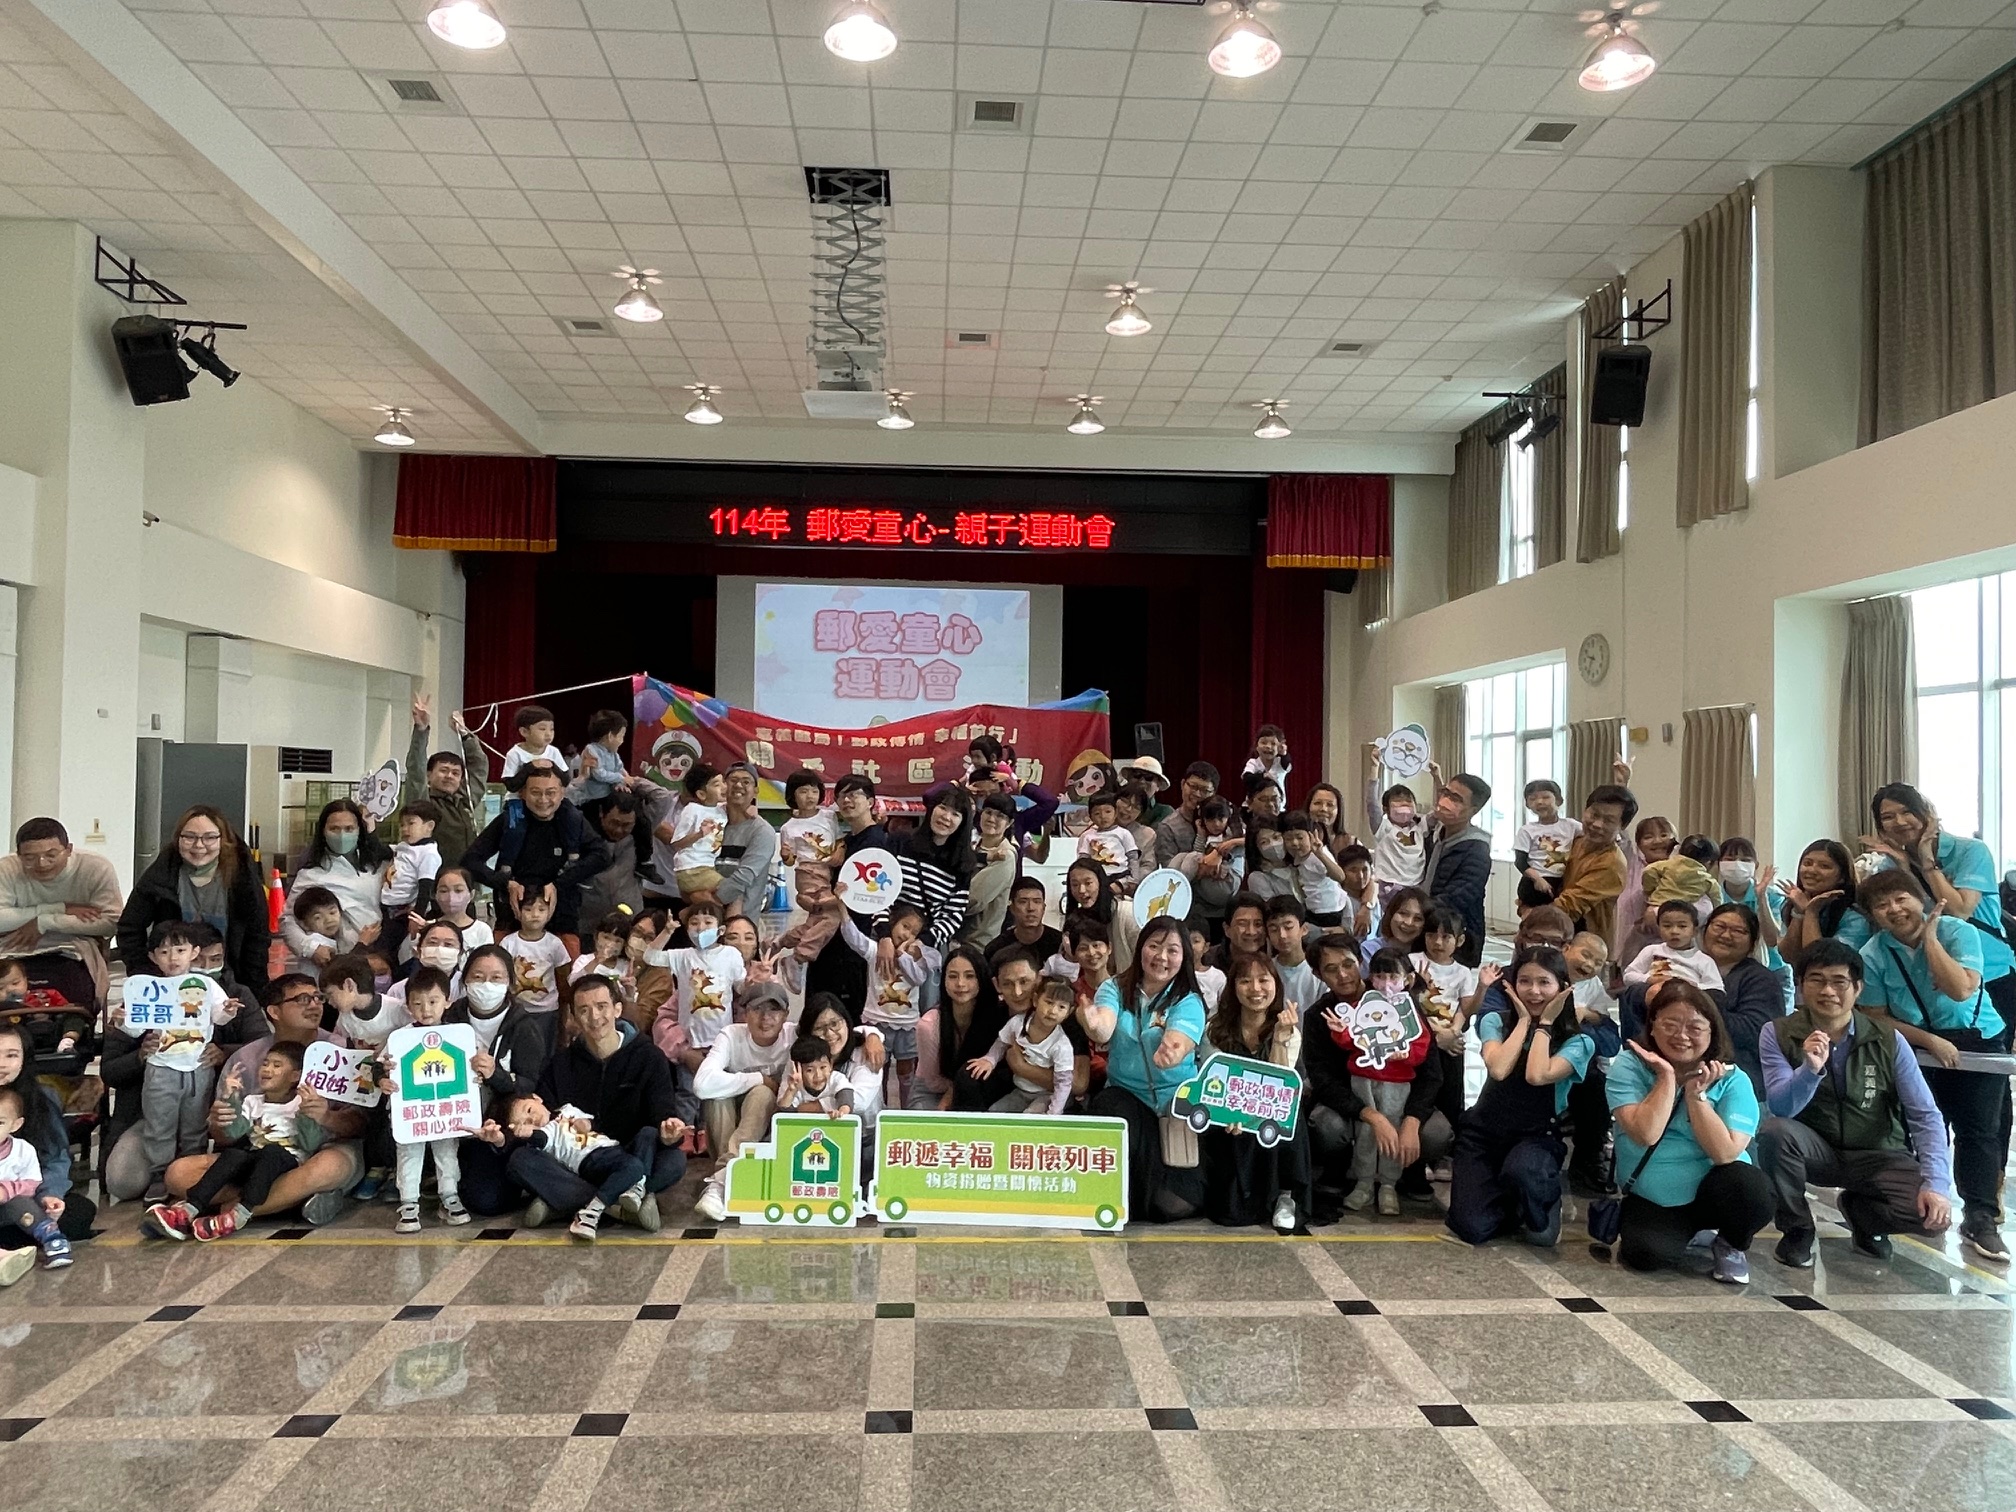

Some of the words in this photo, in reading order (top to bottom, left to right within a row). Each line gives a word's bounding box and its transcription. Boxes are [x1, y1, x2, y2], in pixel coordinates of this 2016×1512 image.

[709, 507, 791, 540] 114年
[806, 508, 1115, 548] 郵愛童心-親子運動會
[813, 608, 983, 655] 郵愛童心
[834, 656, 962, 700] 運動會
[745, 740, 1044, 787] 關社區動
[143, 980, 168, 1002] 小
[131, 1003, 173, 1024] 哥哥
[323, 1050, 348, 1071] 小
[1229, 1077, 1293, 1104] 郵政傳情
[403, 1099, 471, 1121] 郵政壽險
[1226, 1094, 1289, 1120] 幸福前行
[412, 1117, 463, 1137] 關心您
[887, 1140, 993, 1170] 郵遞幸福
[1008, 1143, 1117, 1174] 關懷列車
